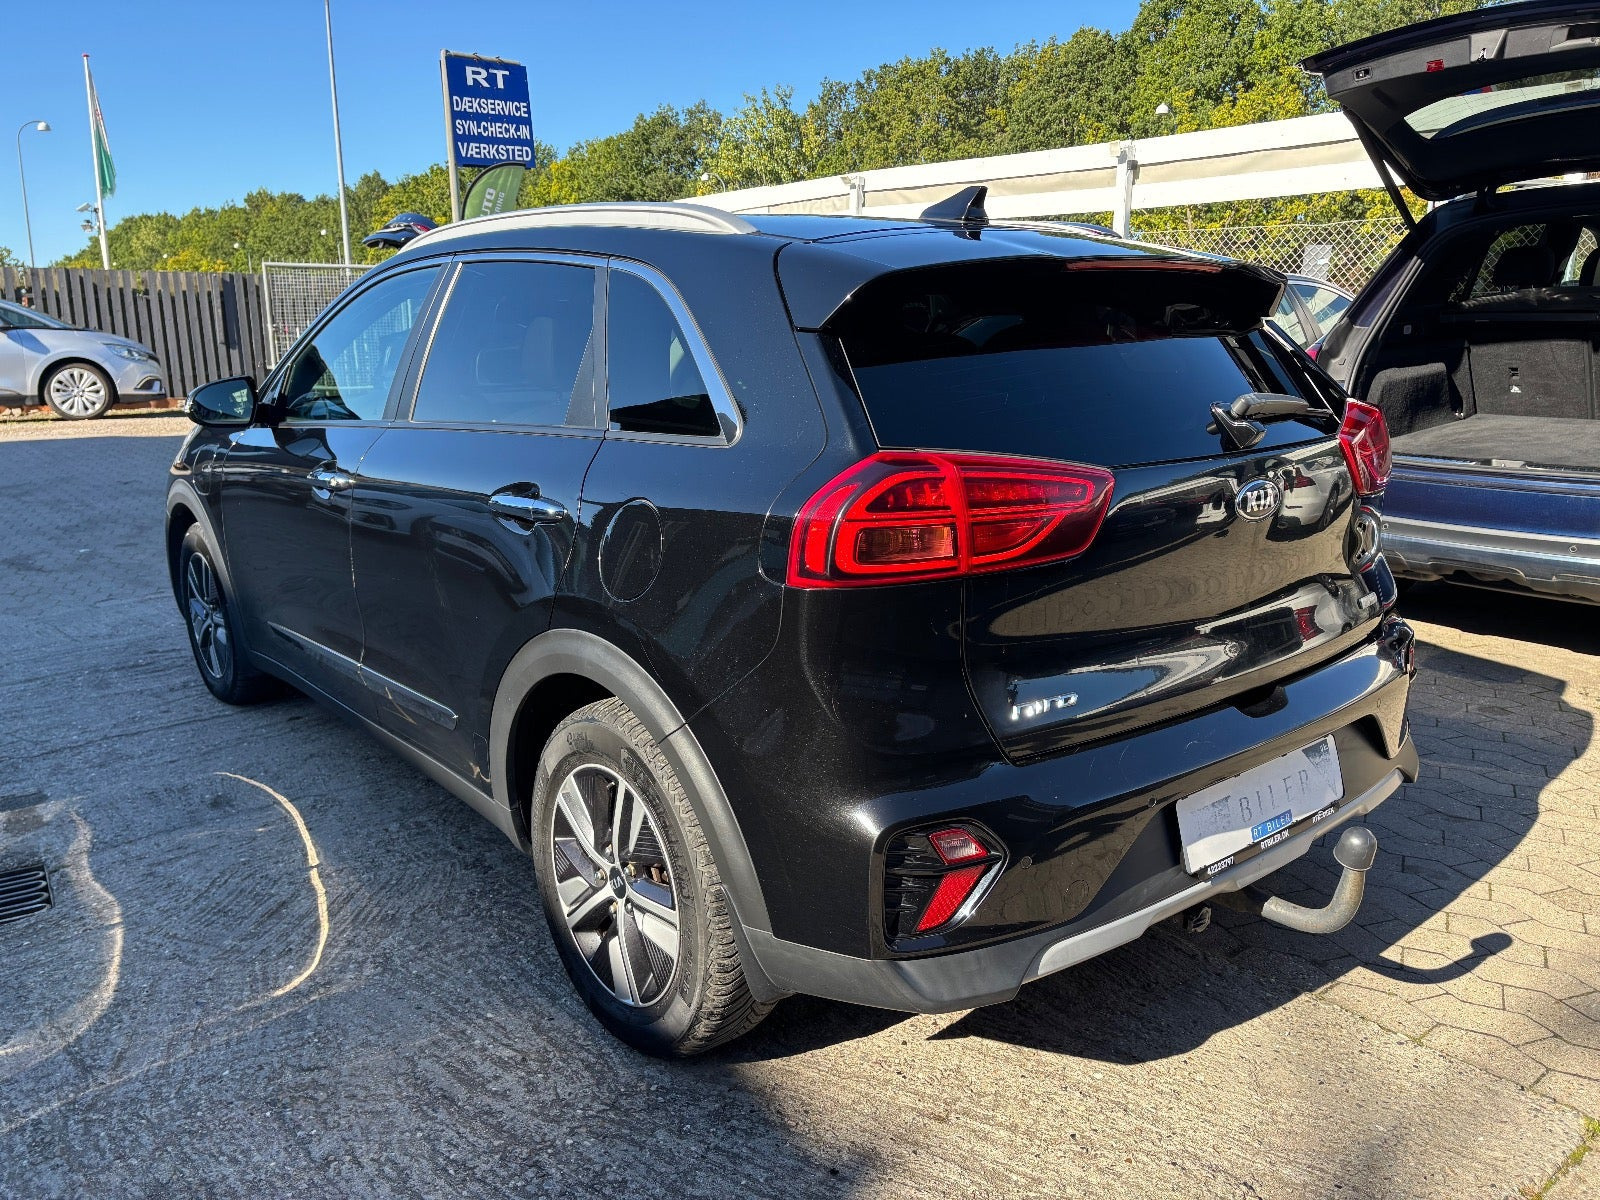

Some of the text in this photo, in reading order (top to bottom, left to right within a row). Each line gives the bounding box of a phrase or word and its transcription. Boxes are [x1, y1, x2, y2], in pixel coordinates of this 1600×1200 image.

[465, 65, 509, 88] RT
[453, 96, 528, 117] DÆKSERVICE
[456, 119, 530, 139] SYN-CHECK-IN
[458, 142, 532, 161] VÆRKSTED
[480, 187, 496, 216] UTO
[1246, 487, 1275, 512] KIA
[1253, 813, 1291, 838] RT BILER
